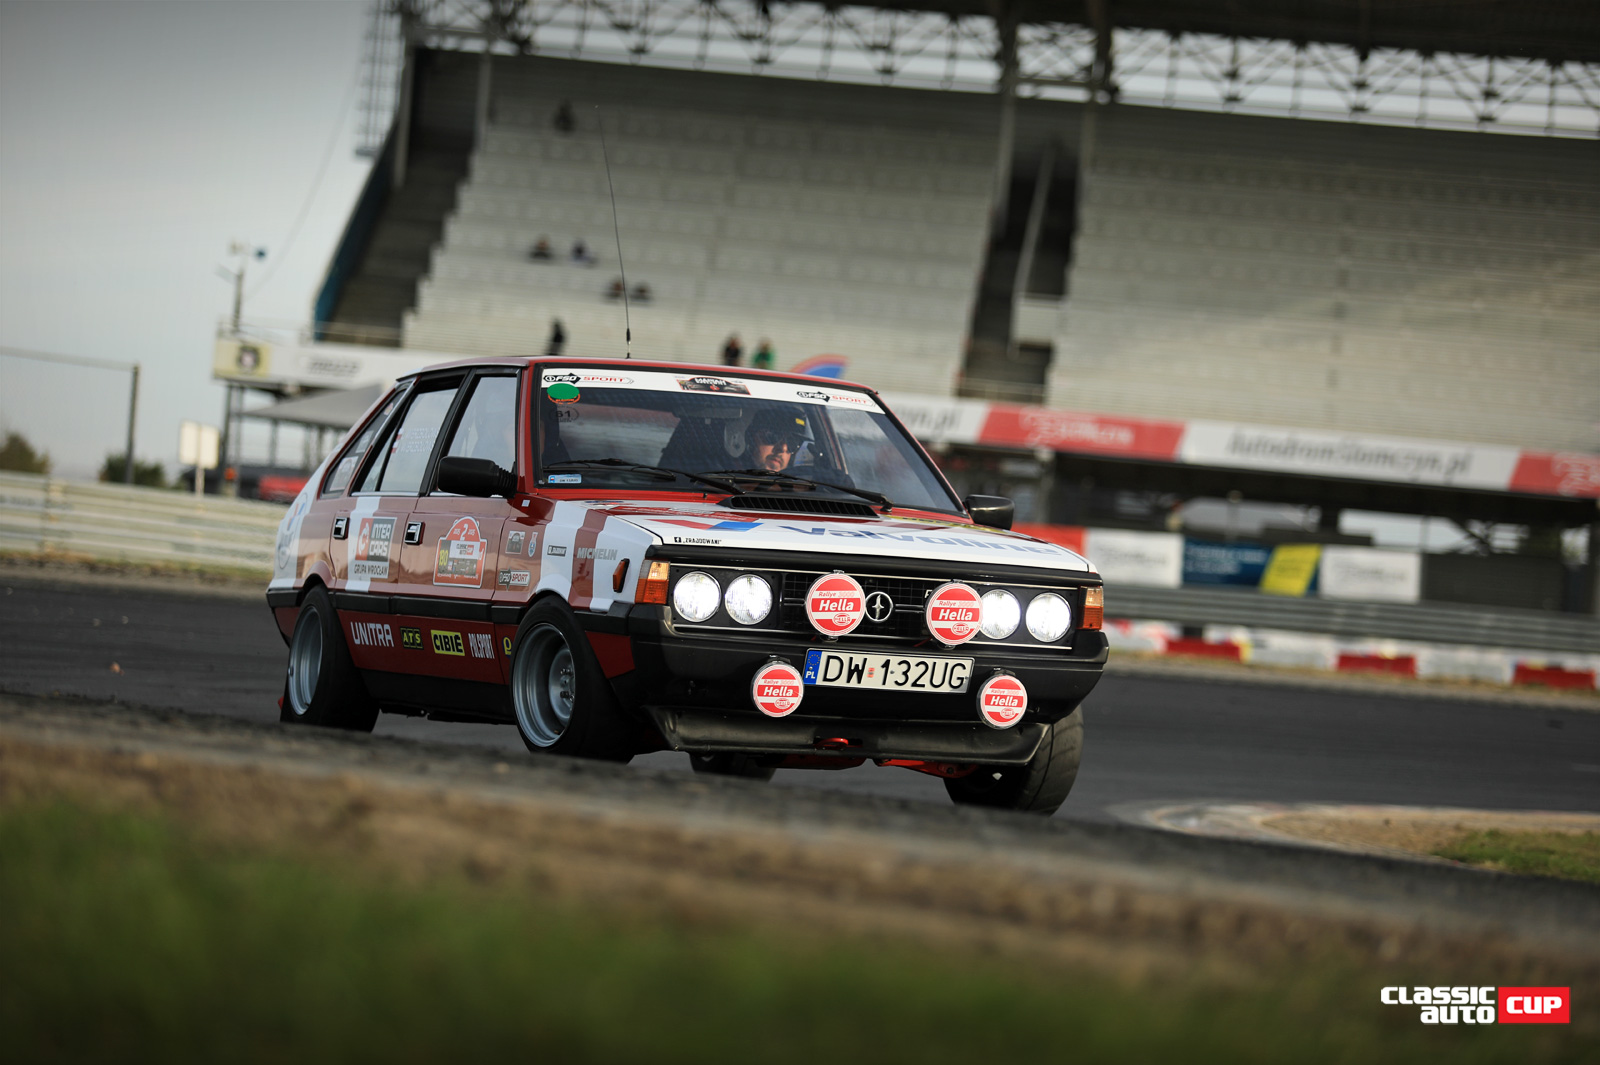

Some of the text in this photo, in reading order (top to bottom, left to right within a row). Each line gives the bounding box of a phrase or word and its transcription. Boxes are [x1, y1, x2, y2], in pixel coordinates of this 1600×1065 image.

[832, 395, 868, 404] SPORT
[371, 523, 392, 540] INTER
[778, 525, 1063, 556] Valvoline
[369, 540, 390, 557] CARS
[577, 547, 619, 561] MICHELIN
[511, 573, 529, 583] SPORT
[818, 598, 855, 611] Hella
[938, 608, 973, 621] Hella
[350, 621, 395, 648] UNITRA
[402, 632, 422, 644] ATS
[805, 655, 967, 690] PL DW 132UG
[763, 686, 794, 697] Hella
[990, 695, 1019, 707] Hella
